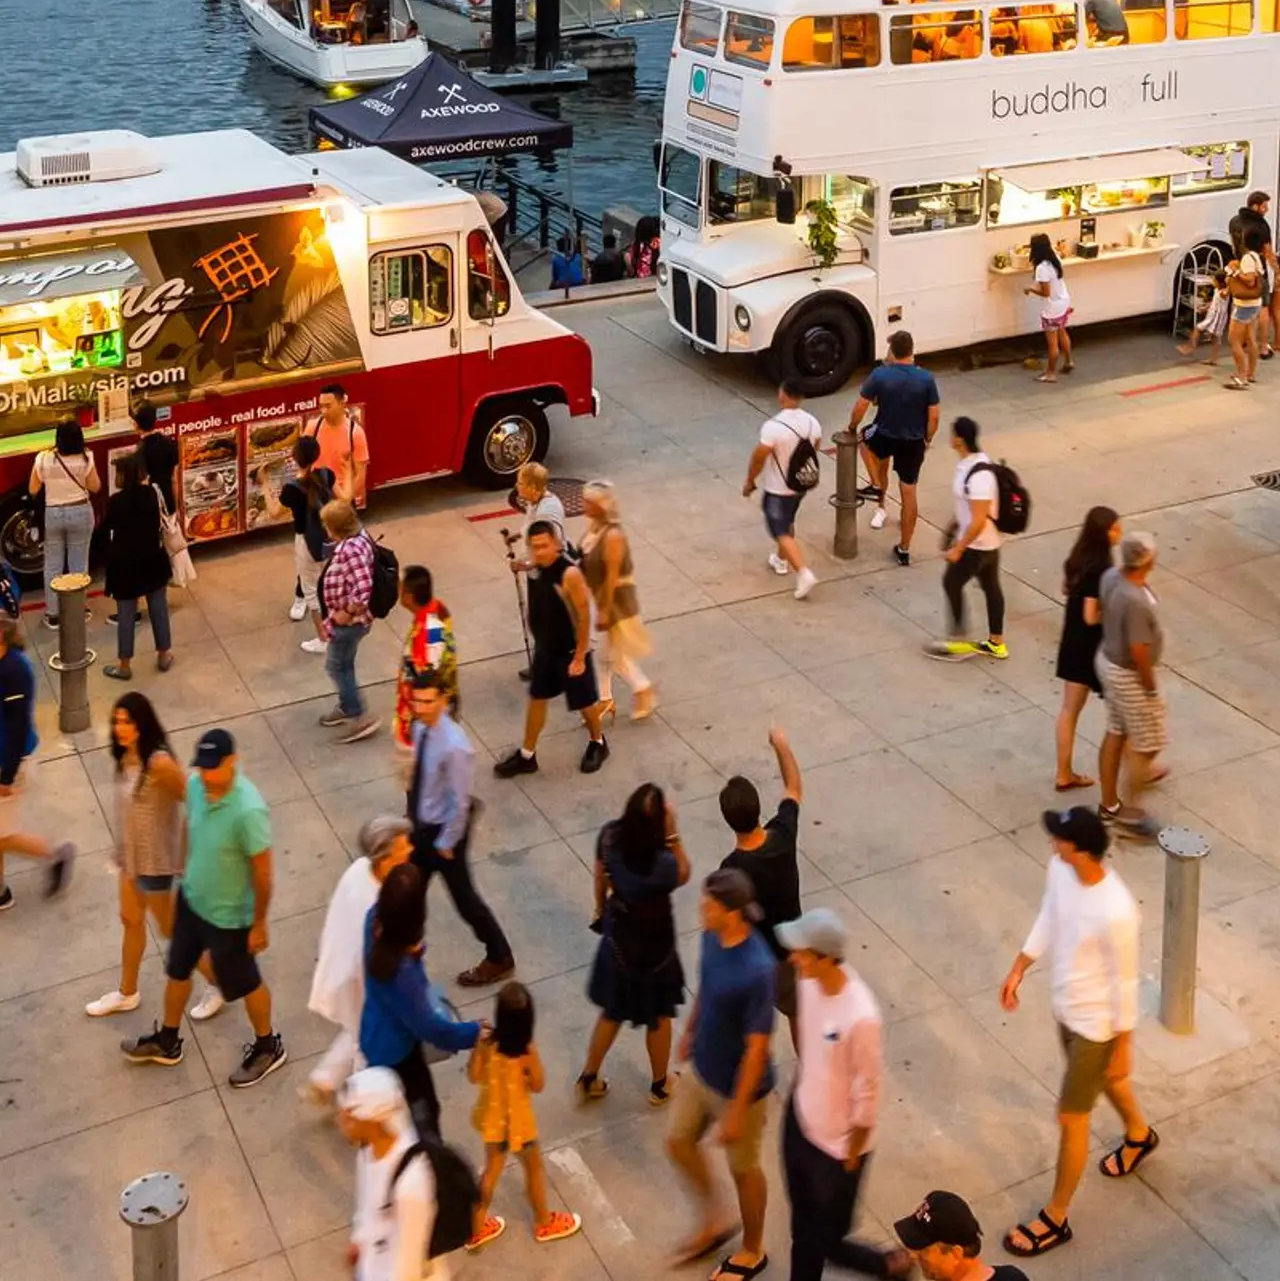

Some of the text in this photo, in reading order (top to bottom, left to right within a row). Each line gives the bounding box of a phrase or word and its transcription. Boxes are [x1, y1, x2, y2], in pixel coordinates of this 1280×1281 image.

[991, 70, 1178, 119] buddha full
[420, 102, 501, 119] AXEWOOD
[410, 134, 539, 158] axewoodcrew.com
[178, 415, 222, 435] people
[231, 407, 255, 422] real
[256, 403, 285, 418] food
[294, 397, 317, 411] real
